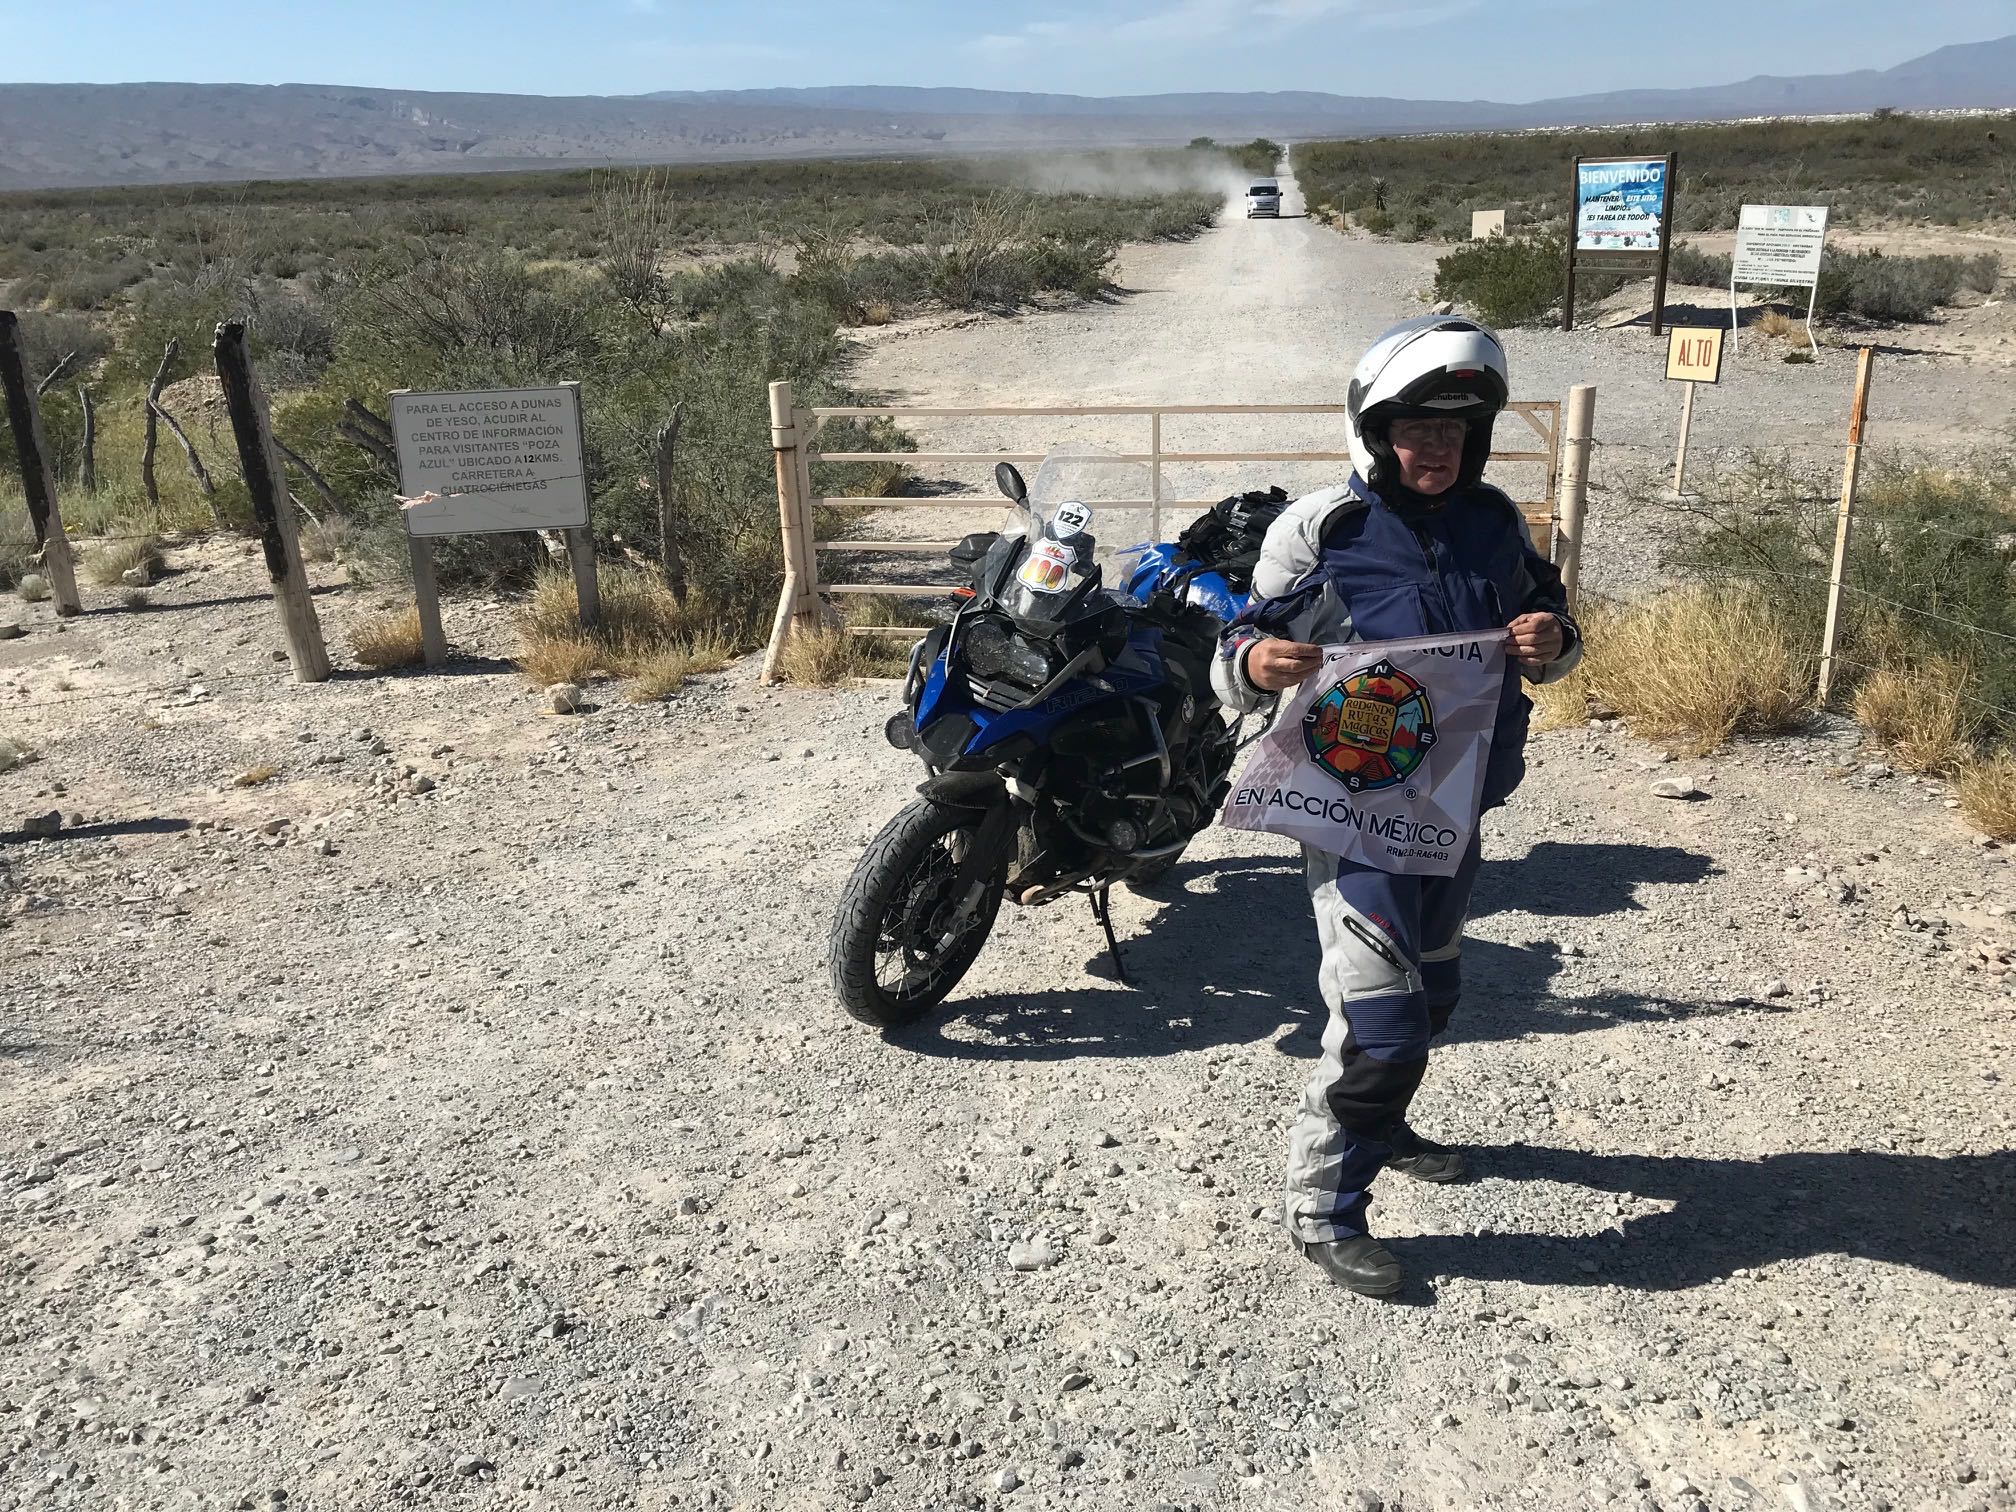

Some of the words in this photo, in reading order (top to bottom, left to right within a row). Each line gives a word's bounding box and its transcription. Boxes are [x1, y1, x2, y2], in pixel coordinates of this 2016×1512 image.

[1581, 168, 1660, 185] BIENVENIDO
[1585, 195, 1620, 203] MANTENER
[1678, 339, 1713, 367] ALTO
[406, 404, 439, 415] PARA
[441, 403, 456, 413] EL
[459, 401, 508, 412] ACCESO
[510, 400, 519, 410] A
[521, 398, 562, 410] DUNAS
[426, 417, 443, 428] DE
[445, 416, 481, 427] YESO,
[483, 414, 528, 425] ACUDIR
[530, 413, 546, 423] AL
[411, 430, 460, 442] CENTRO
[463, 429, 479, 439] DE
[482, 424, 563, 439] INFORMACIÓN
[418, 445, 450, 456] PARA
[452, 441, 520, 454] VISITANTES
[458, 455, 512, 467] UBICADO
[451, 468, 523, 481] CARRETERA
[525, 467, 534, 478] A
[1058, 510, 1084, 527] 122
[1375, 665, 1388, 674] N
[1421, 732, 1432, 743] E
[1349, 776, 1360, 788] S
[1235, 787, 1264, 806] EN
[1268, 790, 1365, 831] ACCIÓN
[1368, 814, 1458, 848] MÉXICO
